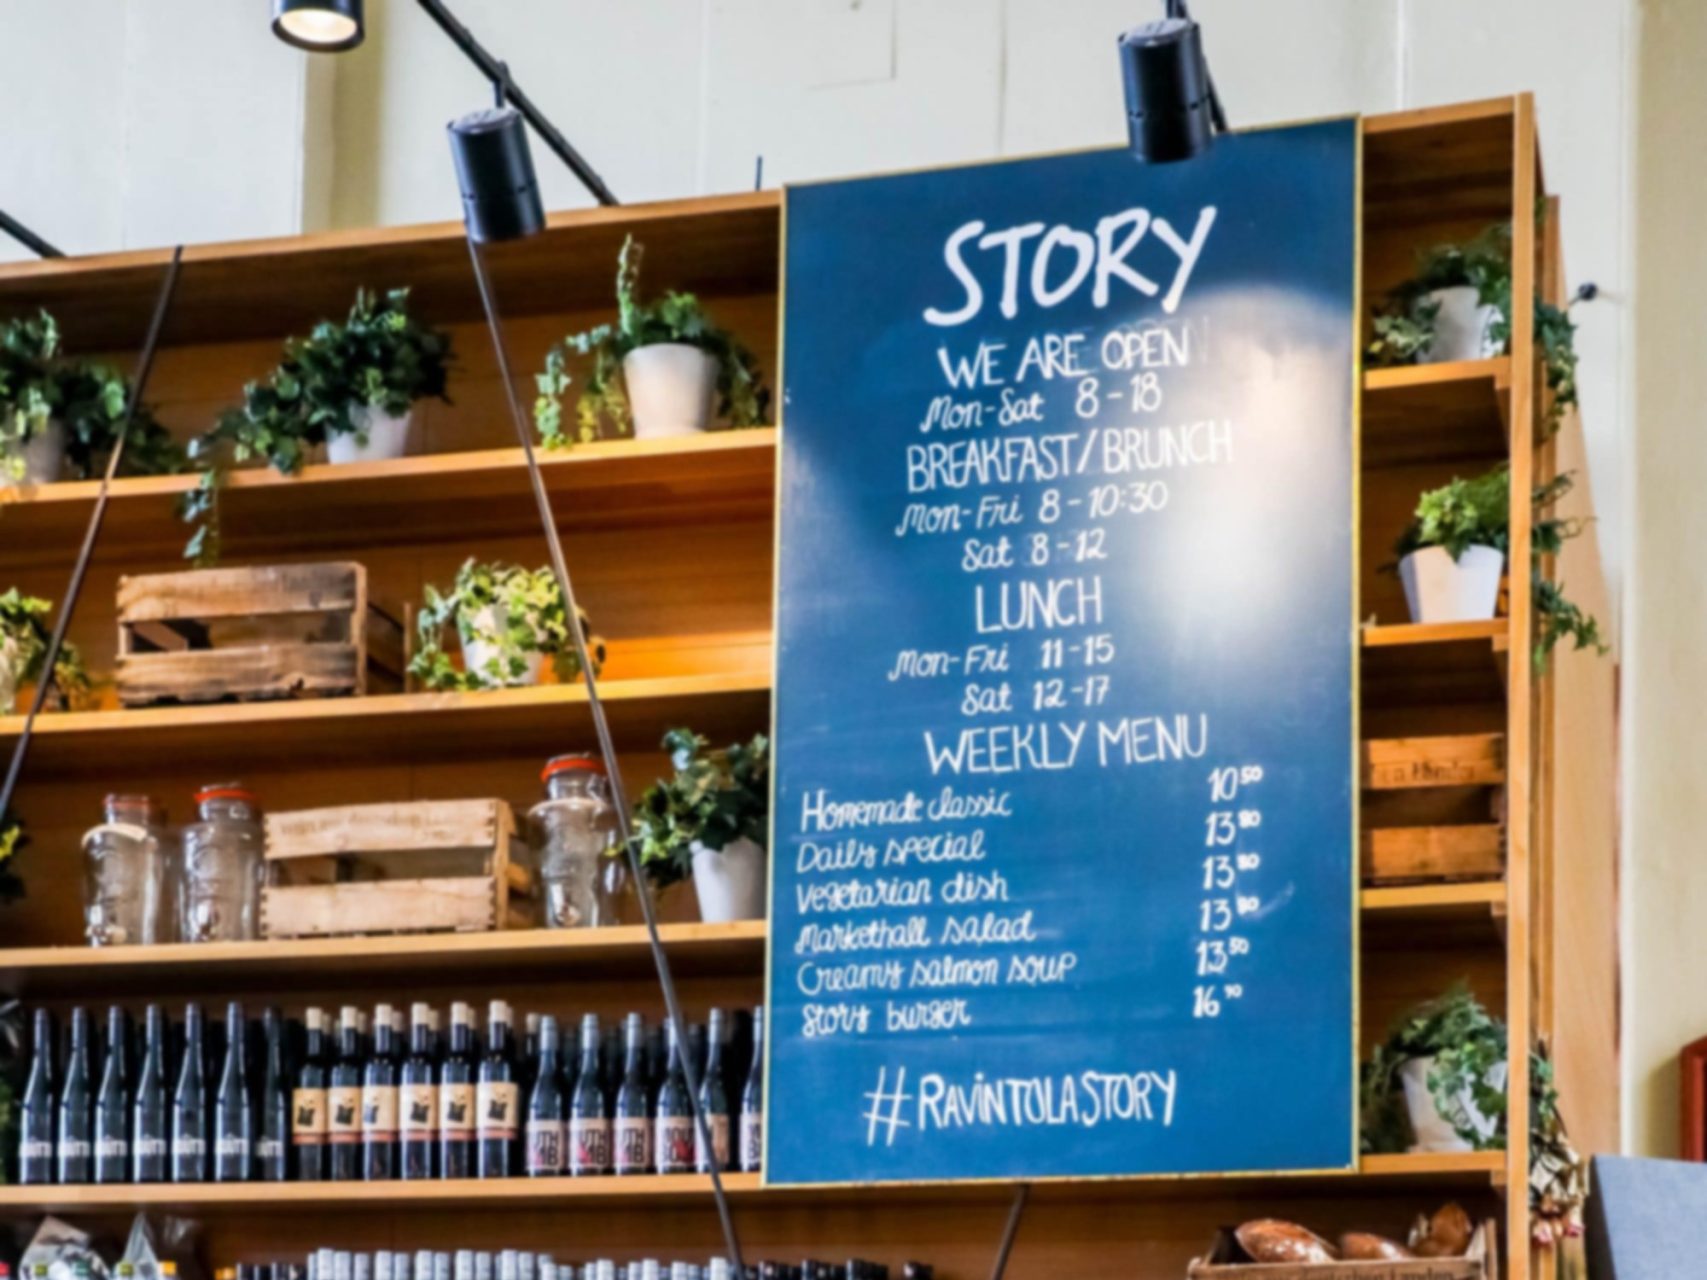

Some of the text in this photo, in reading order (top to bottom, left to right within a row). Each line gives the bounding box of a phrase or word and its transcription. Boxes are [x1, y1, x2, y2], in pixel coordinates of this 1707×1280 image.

[923, 206, 1217, 326] STORY
[938, 327, 1189, 388] WE ARE OPEN
[962, 537, 1013, 571] Sat
[975, 576, 1102, 633] LUNCH
[962, 683, 1013, 716] Sat
[924, 714, 1208, 775] WEEKLY MENU
[801, 790, 921, 832] Homemade
[927, 786, 1013, 824] classic
[882, 829, 986, 867] special
[941, 871, 1008, 903] dish
[940, 910, 1036, 946] salad
[797, 961, 903, 996] Creamy
[909, 955, 998, 988] salmon
[1006, 952, 1077, 985] soup
[886, 998, 971, 1032] burger
